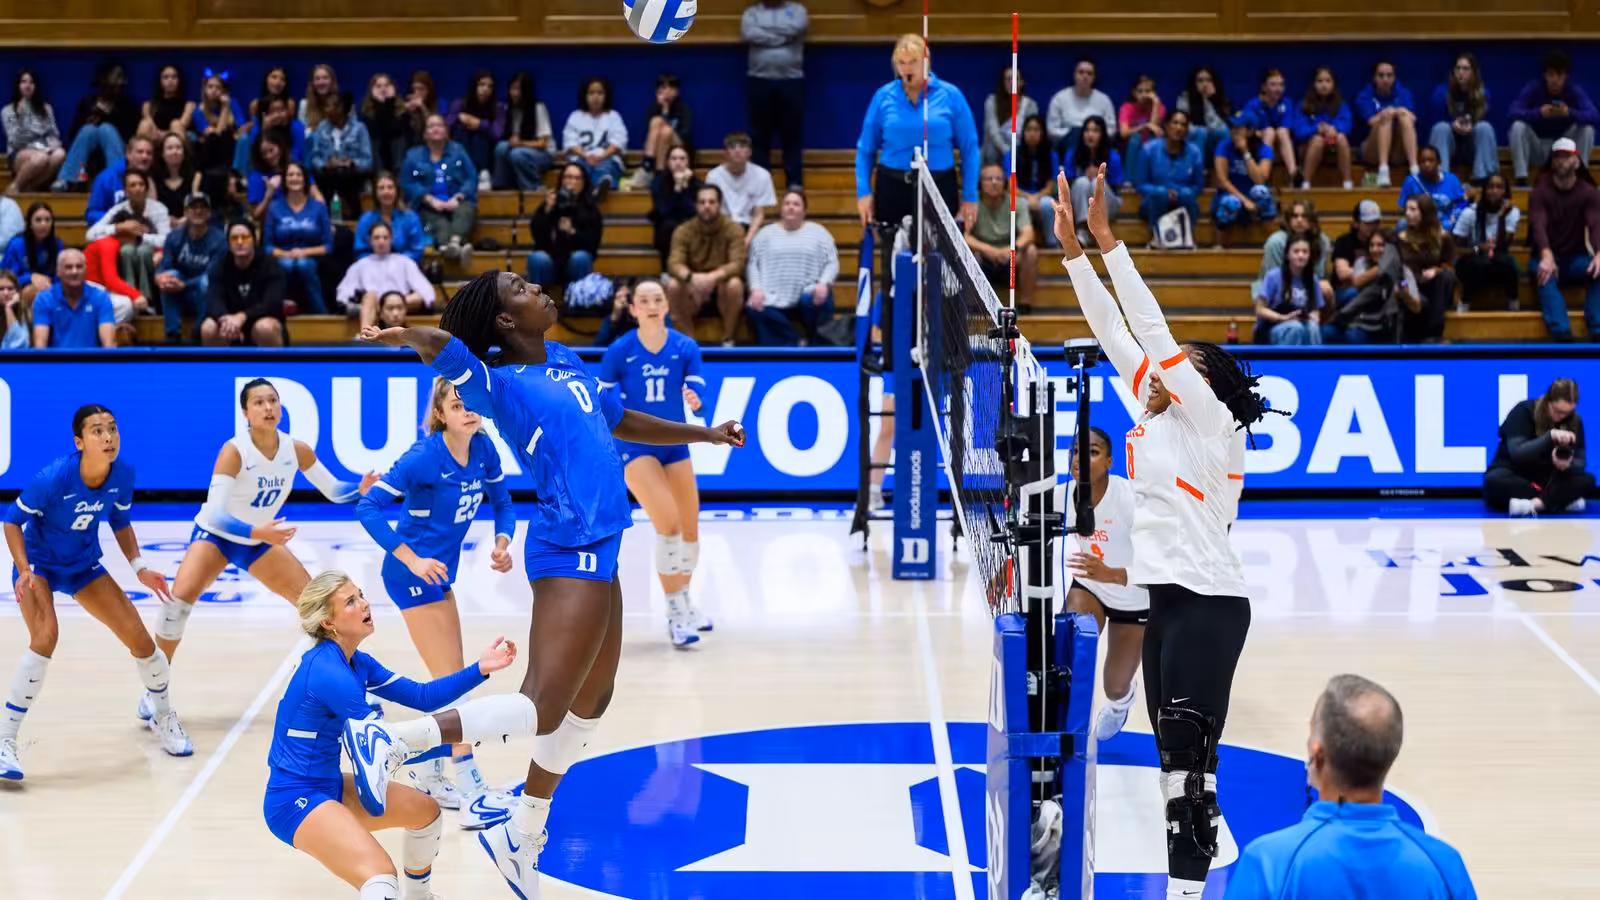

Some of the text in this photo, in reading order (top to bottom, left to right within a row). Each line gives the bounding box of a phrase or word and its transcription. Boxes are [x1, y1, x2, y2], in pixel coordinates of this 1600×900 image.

[579, 130, 610, 150] 24
[641, 363, 670, 377] Duke
[567, 380, 593, 413] 0
[645, 377, 666, 402] 11
[257, 475, 286, 489] Duke
[74, 500, 104, 513] Duke
[250, 489, 282, 508] 10
[454, 492, 484, 523] 23
[71, 514, 94, 530] 8
[900, 537, 929, 564] D
[576, 551, 597, 573] D
